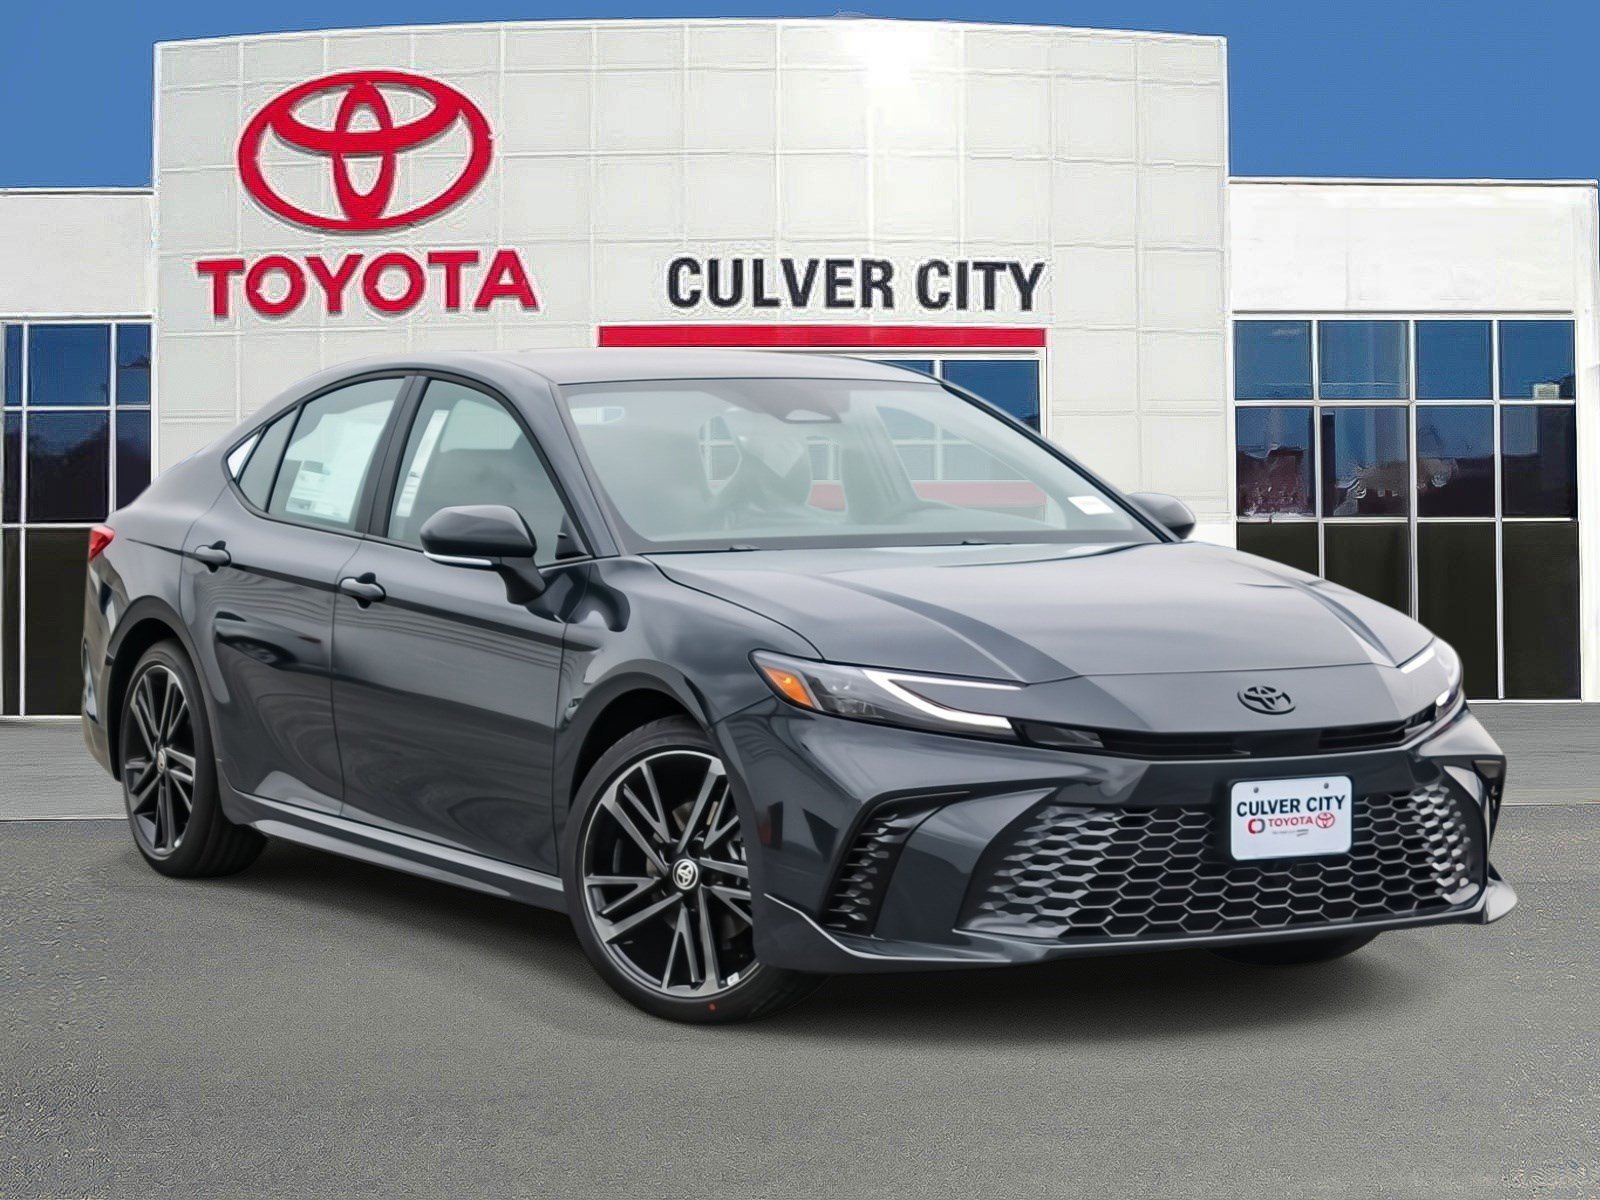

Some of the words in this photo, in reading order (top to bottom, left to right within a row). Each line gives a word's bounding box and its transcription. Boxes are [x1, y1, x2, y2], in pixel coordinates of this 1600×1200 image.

[196, 249, 540, 319] TOYOTA
[667, 257, 895, 309] CULVER
[916, 259, 1046, 311] CITY
[1237, 799, 1300, 817] CULVER
[1306, 795, 1345, 812] CITY
[1269, 816, 1313, 827] TOYOTA
